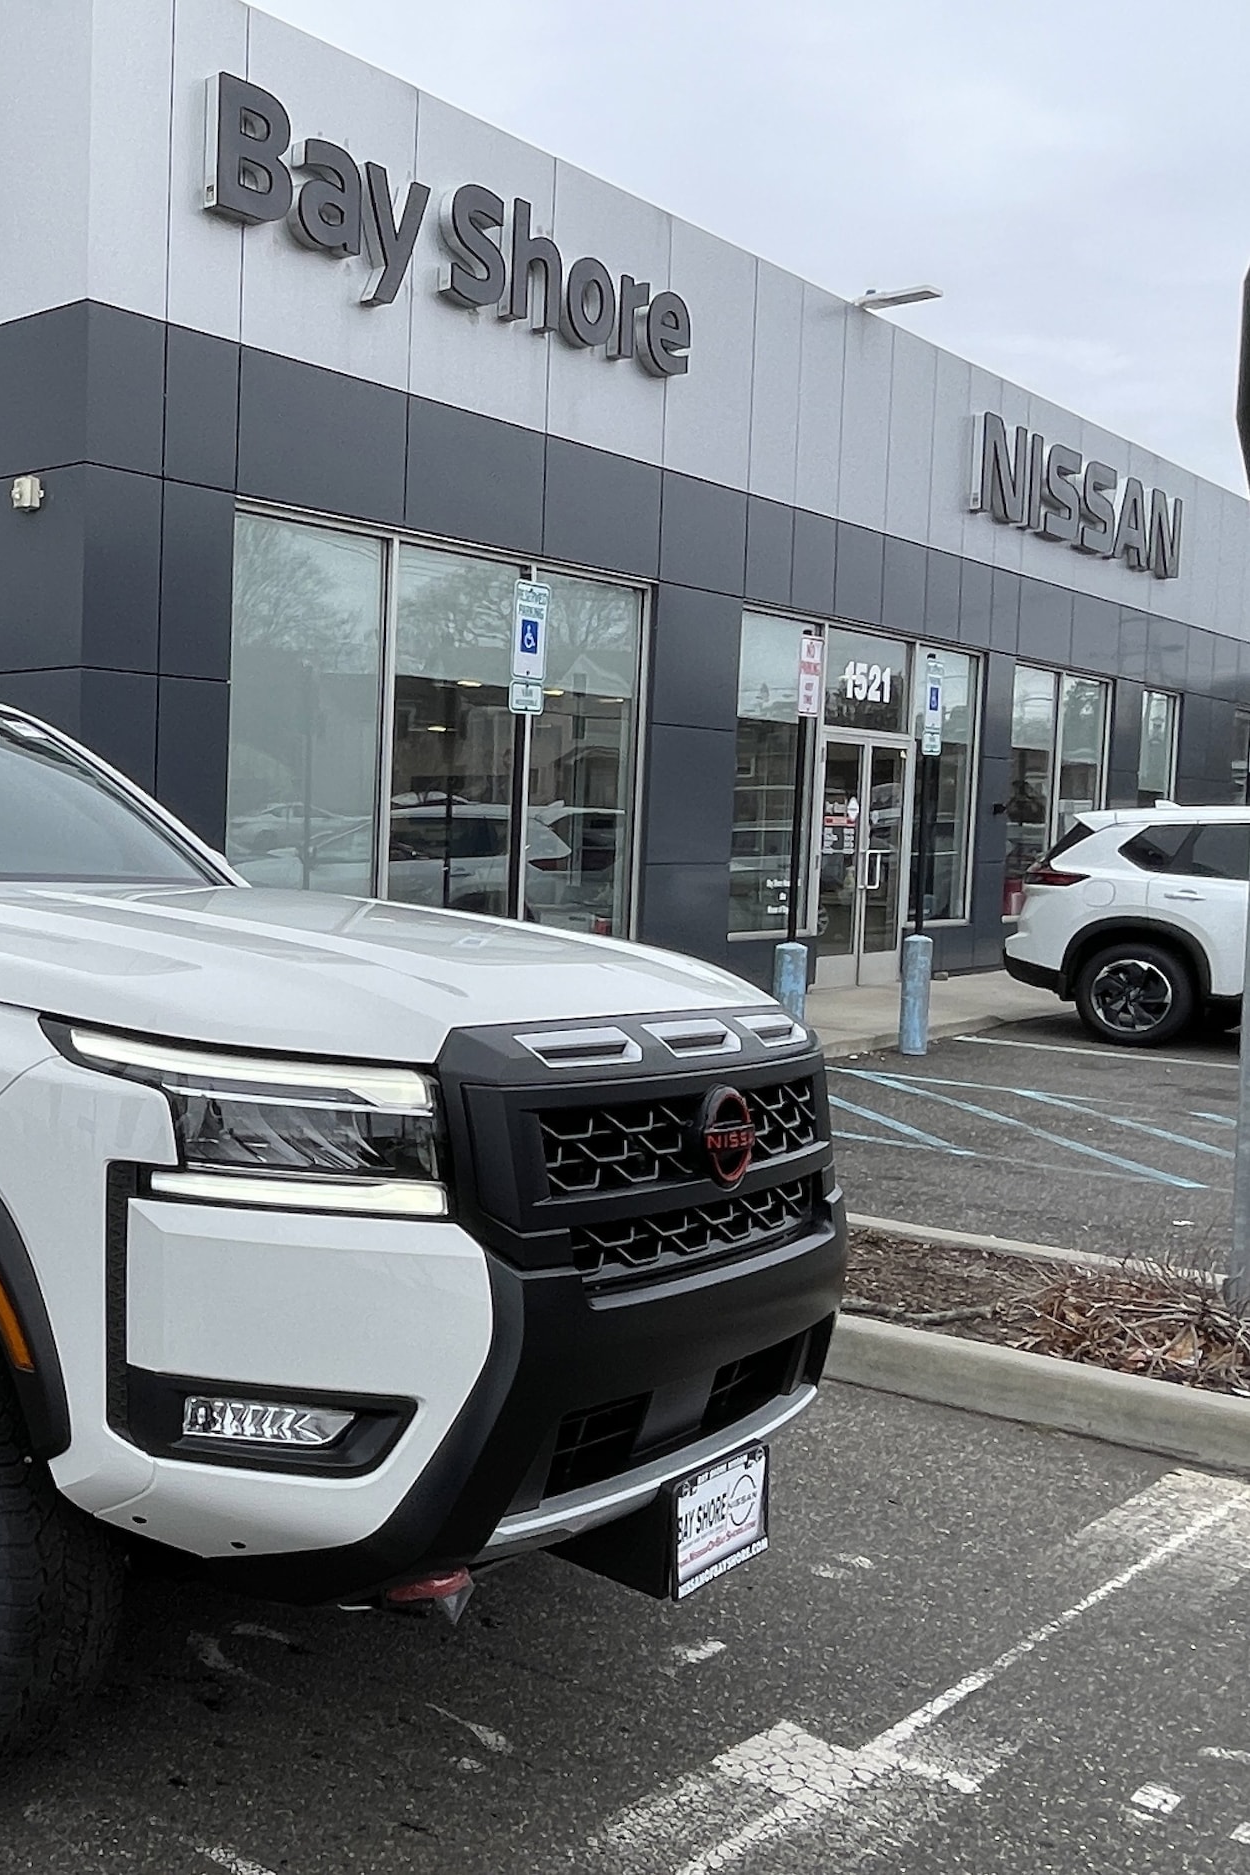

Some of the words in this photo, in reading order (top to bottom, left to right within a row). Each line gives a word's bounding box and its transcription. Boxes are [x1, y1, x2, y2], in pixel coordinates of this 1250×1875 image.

[205, 71, 432, 306] Bay
[438, 183, 692, 378] Shore
[970, 410, 1184, 580] NISSAN
[844, 660, 891, 704] 1521
[707, 1131, 754, 1150] NISS
[695, 1492, 727, 1534] SHORE
